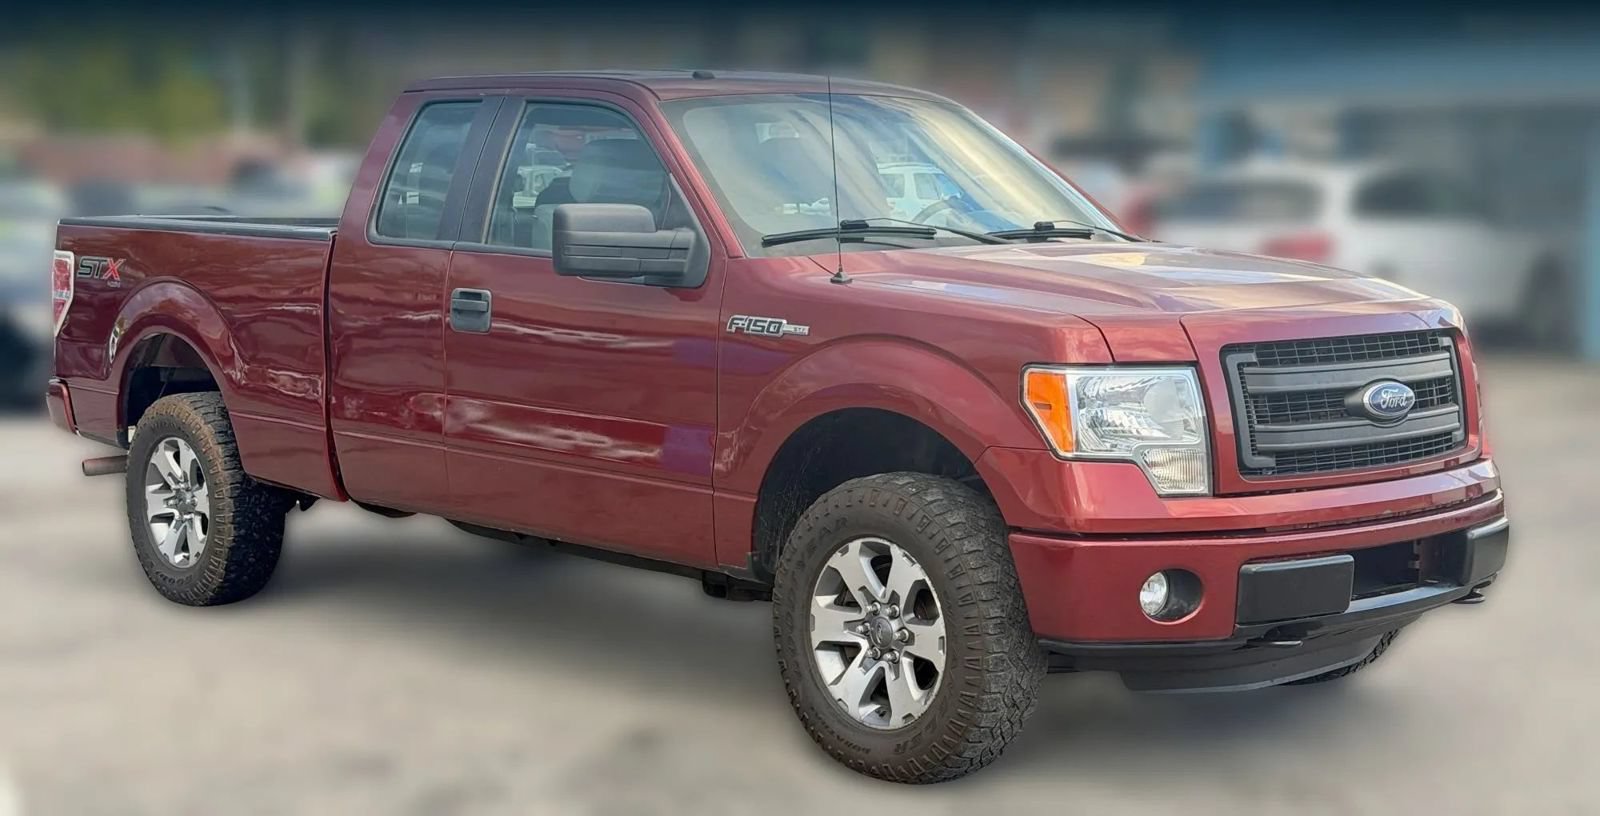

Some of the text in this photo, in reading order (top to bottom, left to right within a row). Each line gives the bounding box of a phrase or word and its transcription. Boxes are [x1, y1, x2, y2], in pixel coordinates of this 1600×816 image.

[77, 256, 126, 280] STX
[726, 315, 787, 337] F-150
[1380, 388, 1408, 409] Ford
